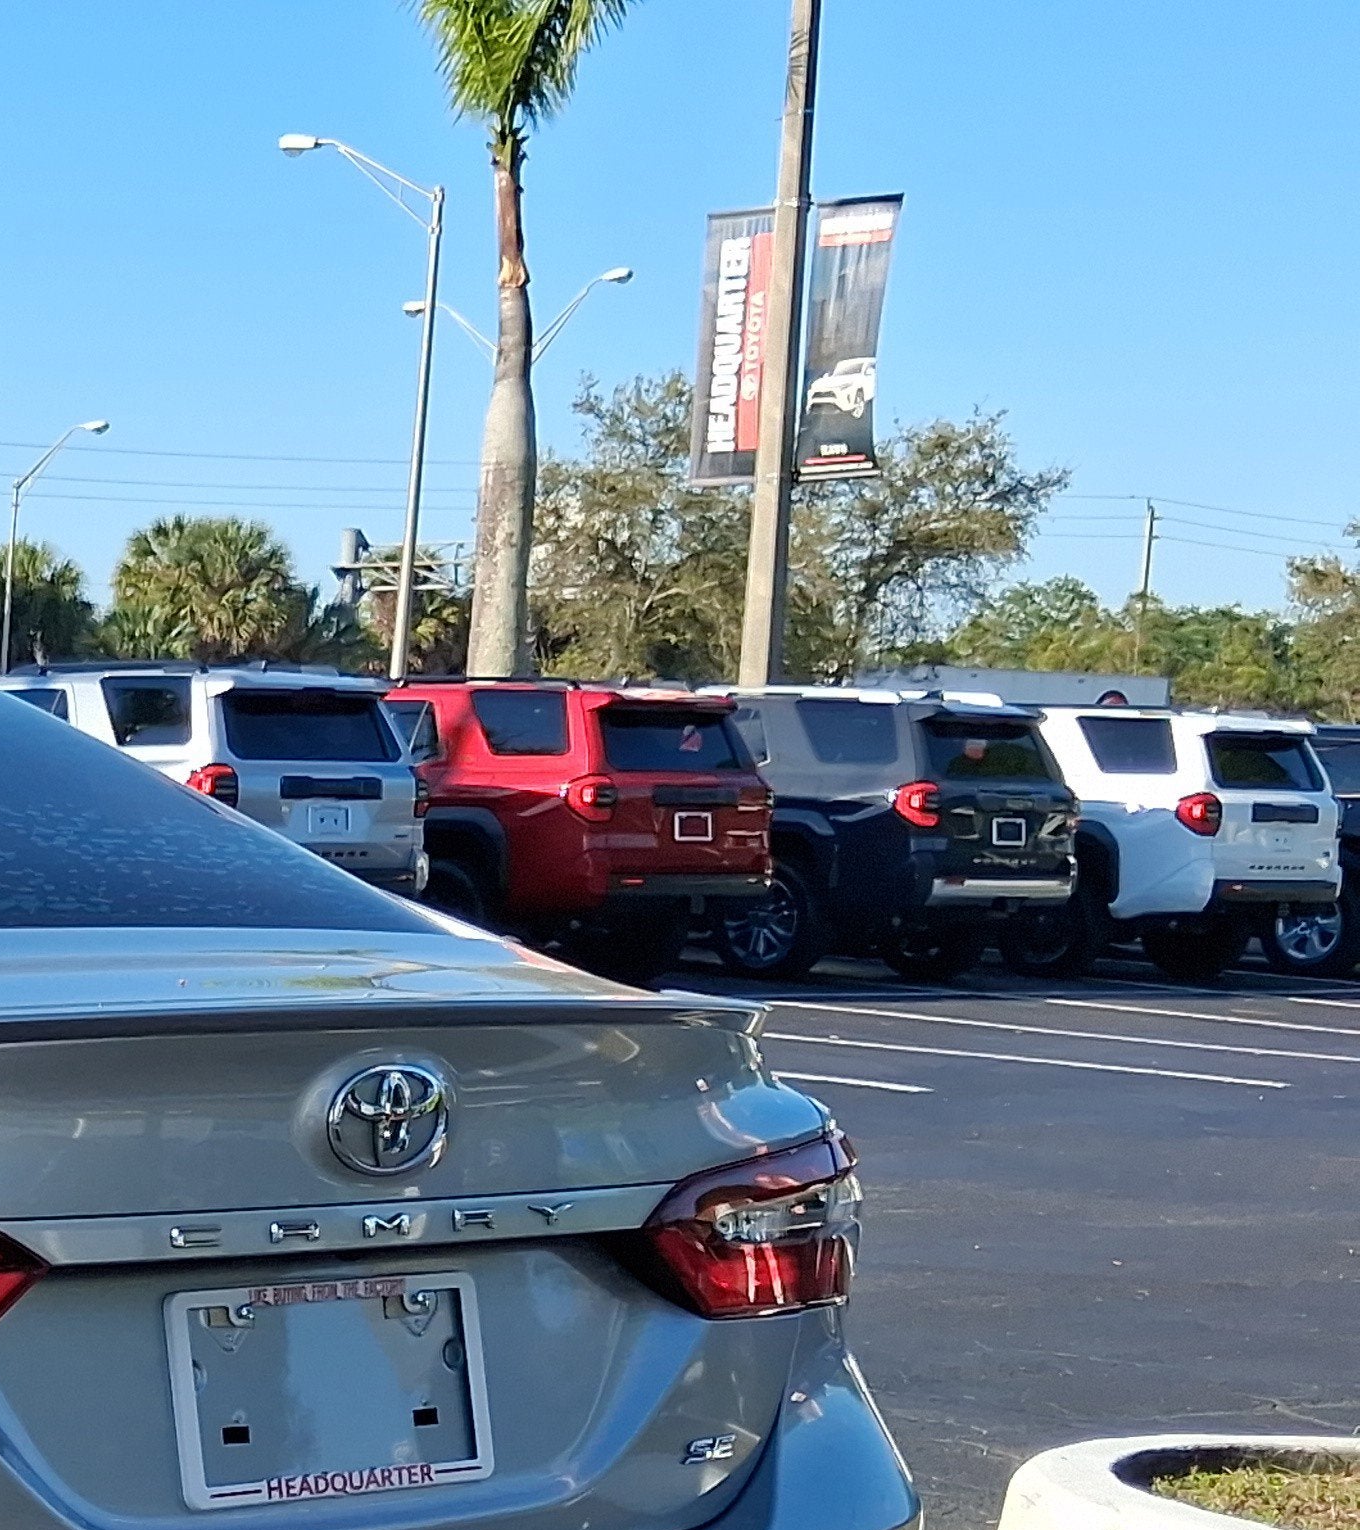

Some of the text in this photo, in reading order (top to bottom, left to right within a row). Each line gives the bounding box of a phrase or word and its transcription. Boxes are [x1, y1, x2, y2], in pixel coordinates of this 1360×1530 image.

[707, 236, 751, 453] HEADQUARTER
[169, 1202, 575, 1249] CAMRY
[683, 1433, 737, 1465] SE
[266, 1463, 435, 1500] HEADQUARTER
